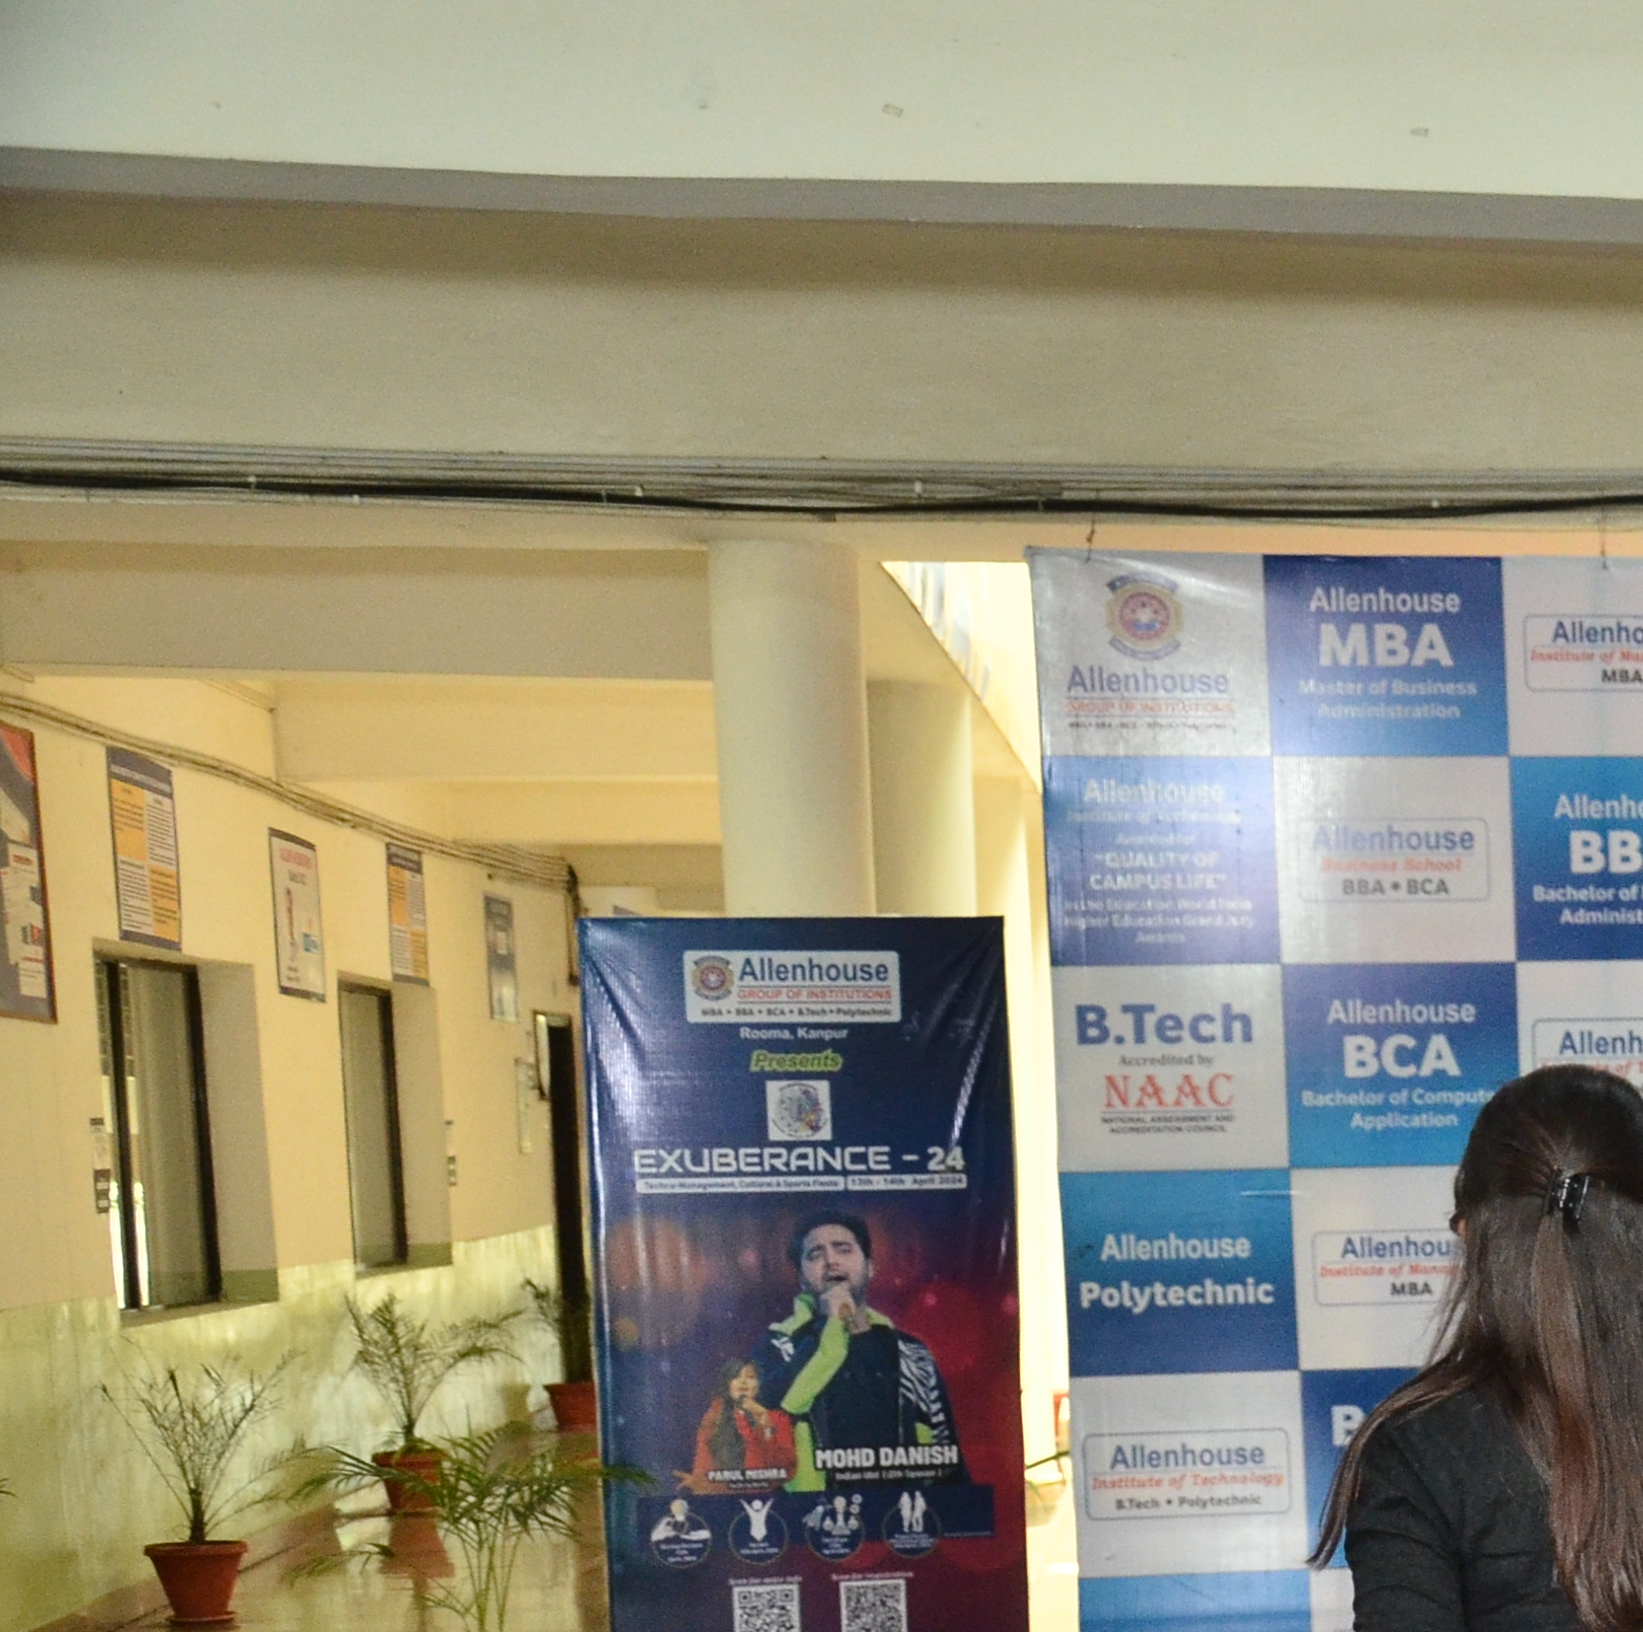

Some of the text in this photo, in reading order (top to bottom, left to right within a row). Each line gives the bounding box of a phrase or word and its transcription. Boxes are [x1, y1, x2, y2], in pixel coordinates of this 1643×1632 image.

[1309, 586, 1461, 613] Allenhouse
[1319, 622, 1454, 667] MBA
[1599, 649, 1615, 665] of
[1067, 665, 1229, 694] Allenhouse
[1601, 669, 1643, 684] MBA
[1300, 679, 1478, 697] Master of Business
[1319, 703, 1461, 720] Administration
[1084, 778, 1226, 803] Allenhouse
[1313, 824, 1475, 851] Allenhouse
[1403, 856, 1464, 872] School
[1089, 873, 1171, 890] CAMPUS
[1342, 878, 1449, 895] BBA BCA
[1533, 885, 1615, 902] Bachelor
[1620, 885, 1639, 902] of
[739, 957, 889, 982] Allenhouse
[738, 989, 783, 999] GROUP
[786, 989, 803, 999] OF
[1328, 999, 1476, 1024] Allenhouse
[739, 1027, 849, 1041] Rooma, Kanpur
[1076, 1002, 1253, 1045] B.Tech
[751, 1048, 843, 1072] Presents
[1119, 1054, 1213, 1068] Accredited by
[1343, 1033, 1462, 1078] BCA
[1104, 1072, 1235, 1109] NAAC
[1302, 1089, 1384, 1106] Bachelor
[1388, 1089, 1407, 1105] of
[1350, 1112, 1459, 1131] Application
[634, 1146, 891, 1174] EXUBERANCE
[927, 1146, 965, 1171] 24
[1101, 1233, 1251, 1263] Allenhouse
[1079, 1278, 1275, 1315] Polytechnic
[1391, 1282, 1432, 1296] MBA
[816, 1445, 958, 1469] MOHD DANISH
[1110, 1443, 1265, 1470] Allenhouse
[1092, 1472, 1285, 1490] Institute of Technology
[1115, 1494, 1263, 1510] B.Tech Polytechnic
